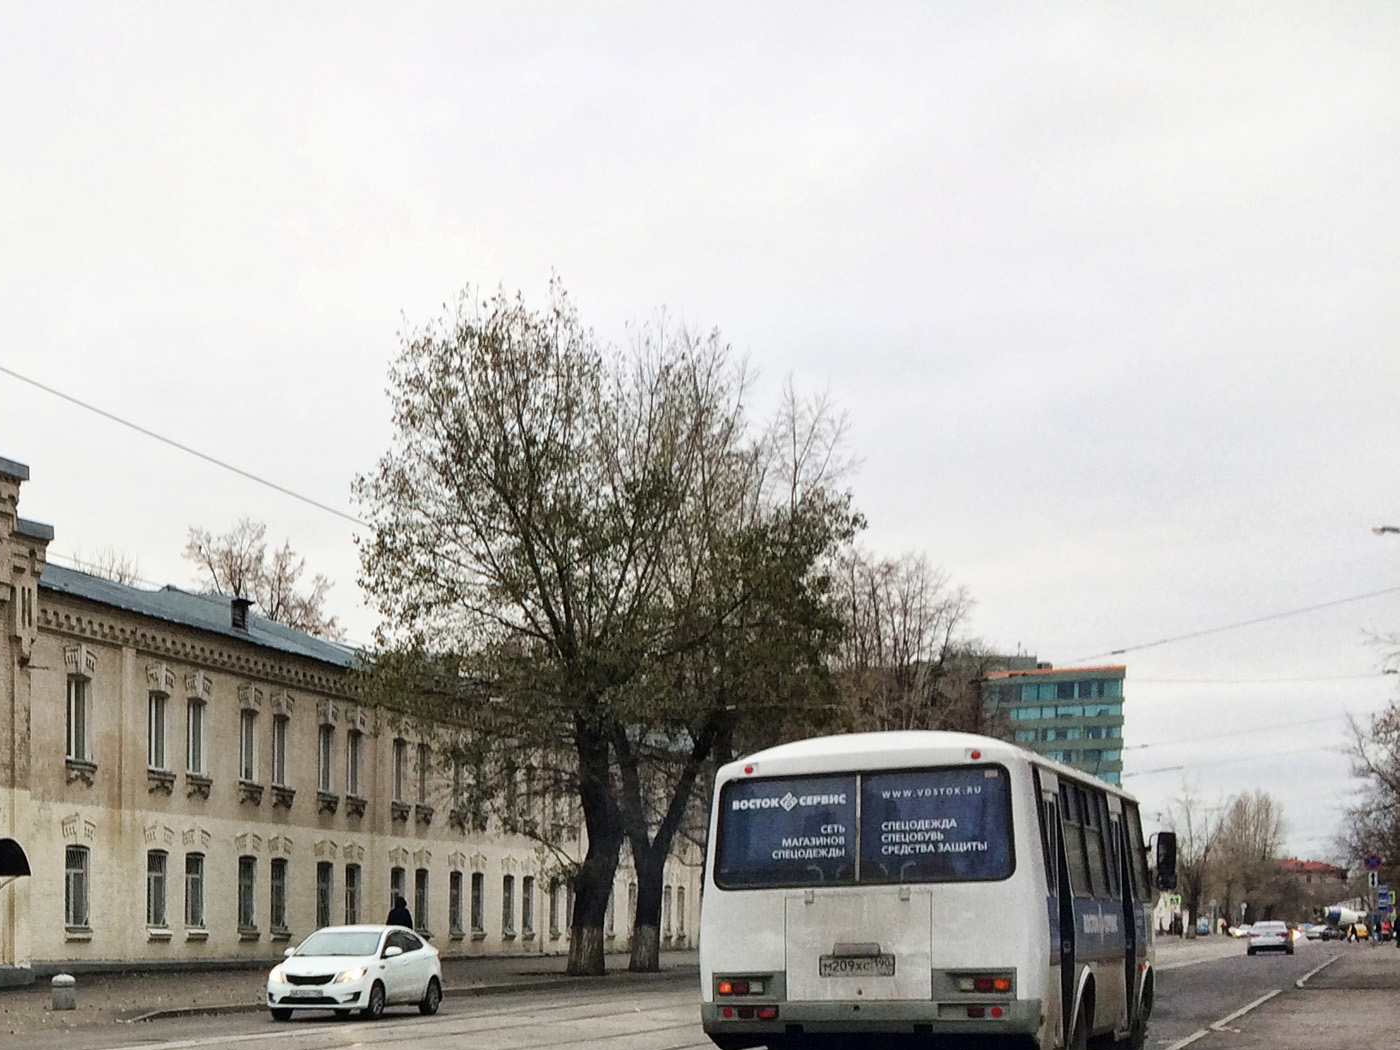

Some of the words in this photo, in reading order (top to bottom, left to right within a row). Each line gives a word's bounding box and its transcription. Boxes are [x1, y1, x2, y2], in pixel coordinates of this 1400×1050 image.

[881, 785, 982, 799] WWW.VOSTOK.RU
[732, 797, 780, 811] ВОСТОК
[799, 793, 846, 806] СЕРВИС
[820, 824, 846, 834] СЕТЬ
[881, 818, 958, 831] СПЕЦОДЕЖДА
[781, 835, 846, 847] МАГАЗИНОВ
[881, 831, 944, 844] СПЕЦОБУВЬ
[772, 847, 845, 860] СПЕЦОДЕЖДЫ
[881, 843, 936, 856] СРЕДСТВА
[937, 841, 988, 853] ЗАЩИТЫ
